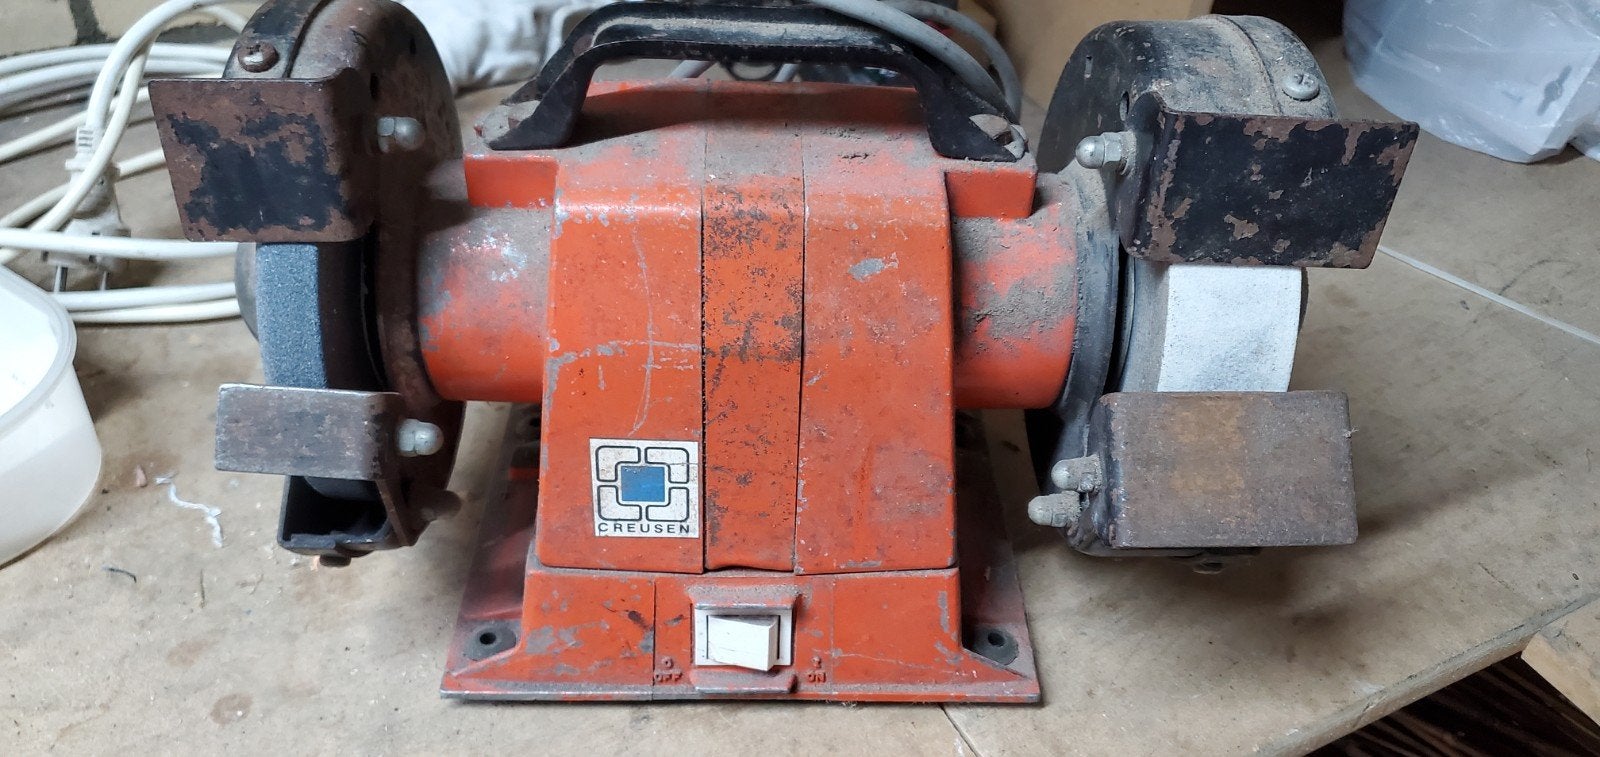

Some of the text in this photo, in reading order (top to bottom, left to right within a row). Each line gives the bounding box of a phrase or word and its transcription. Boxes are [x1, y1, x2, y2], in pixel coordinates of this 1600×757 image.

[597, 522, 690, 534] CREUSEN
[653, 671, 683, 683] OFF
[807, 672, 826, 684] ON
